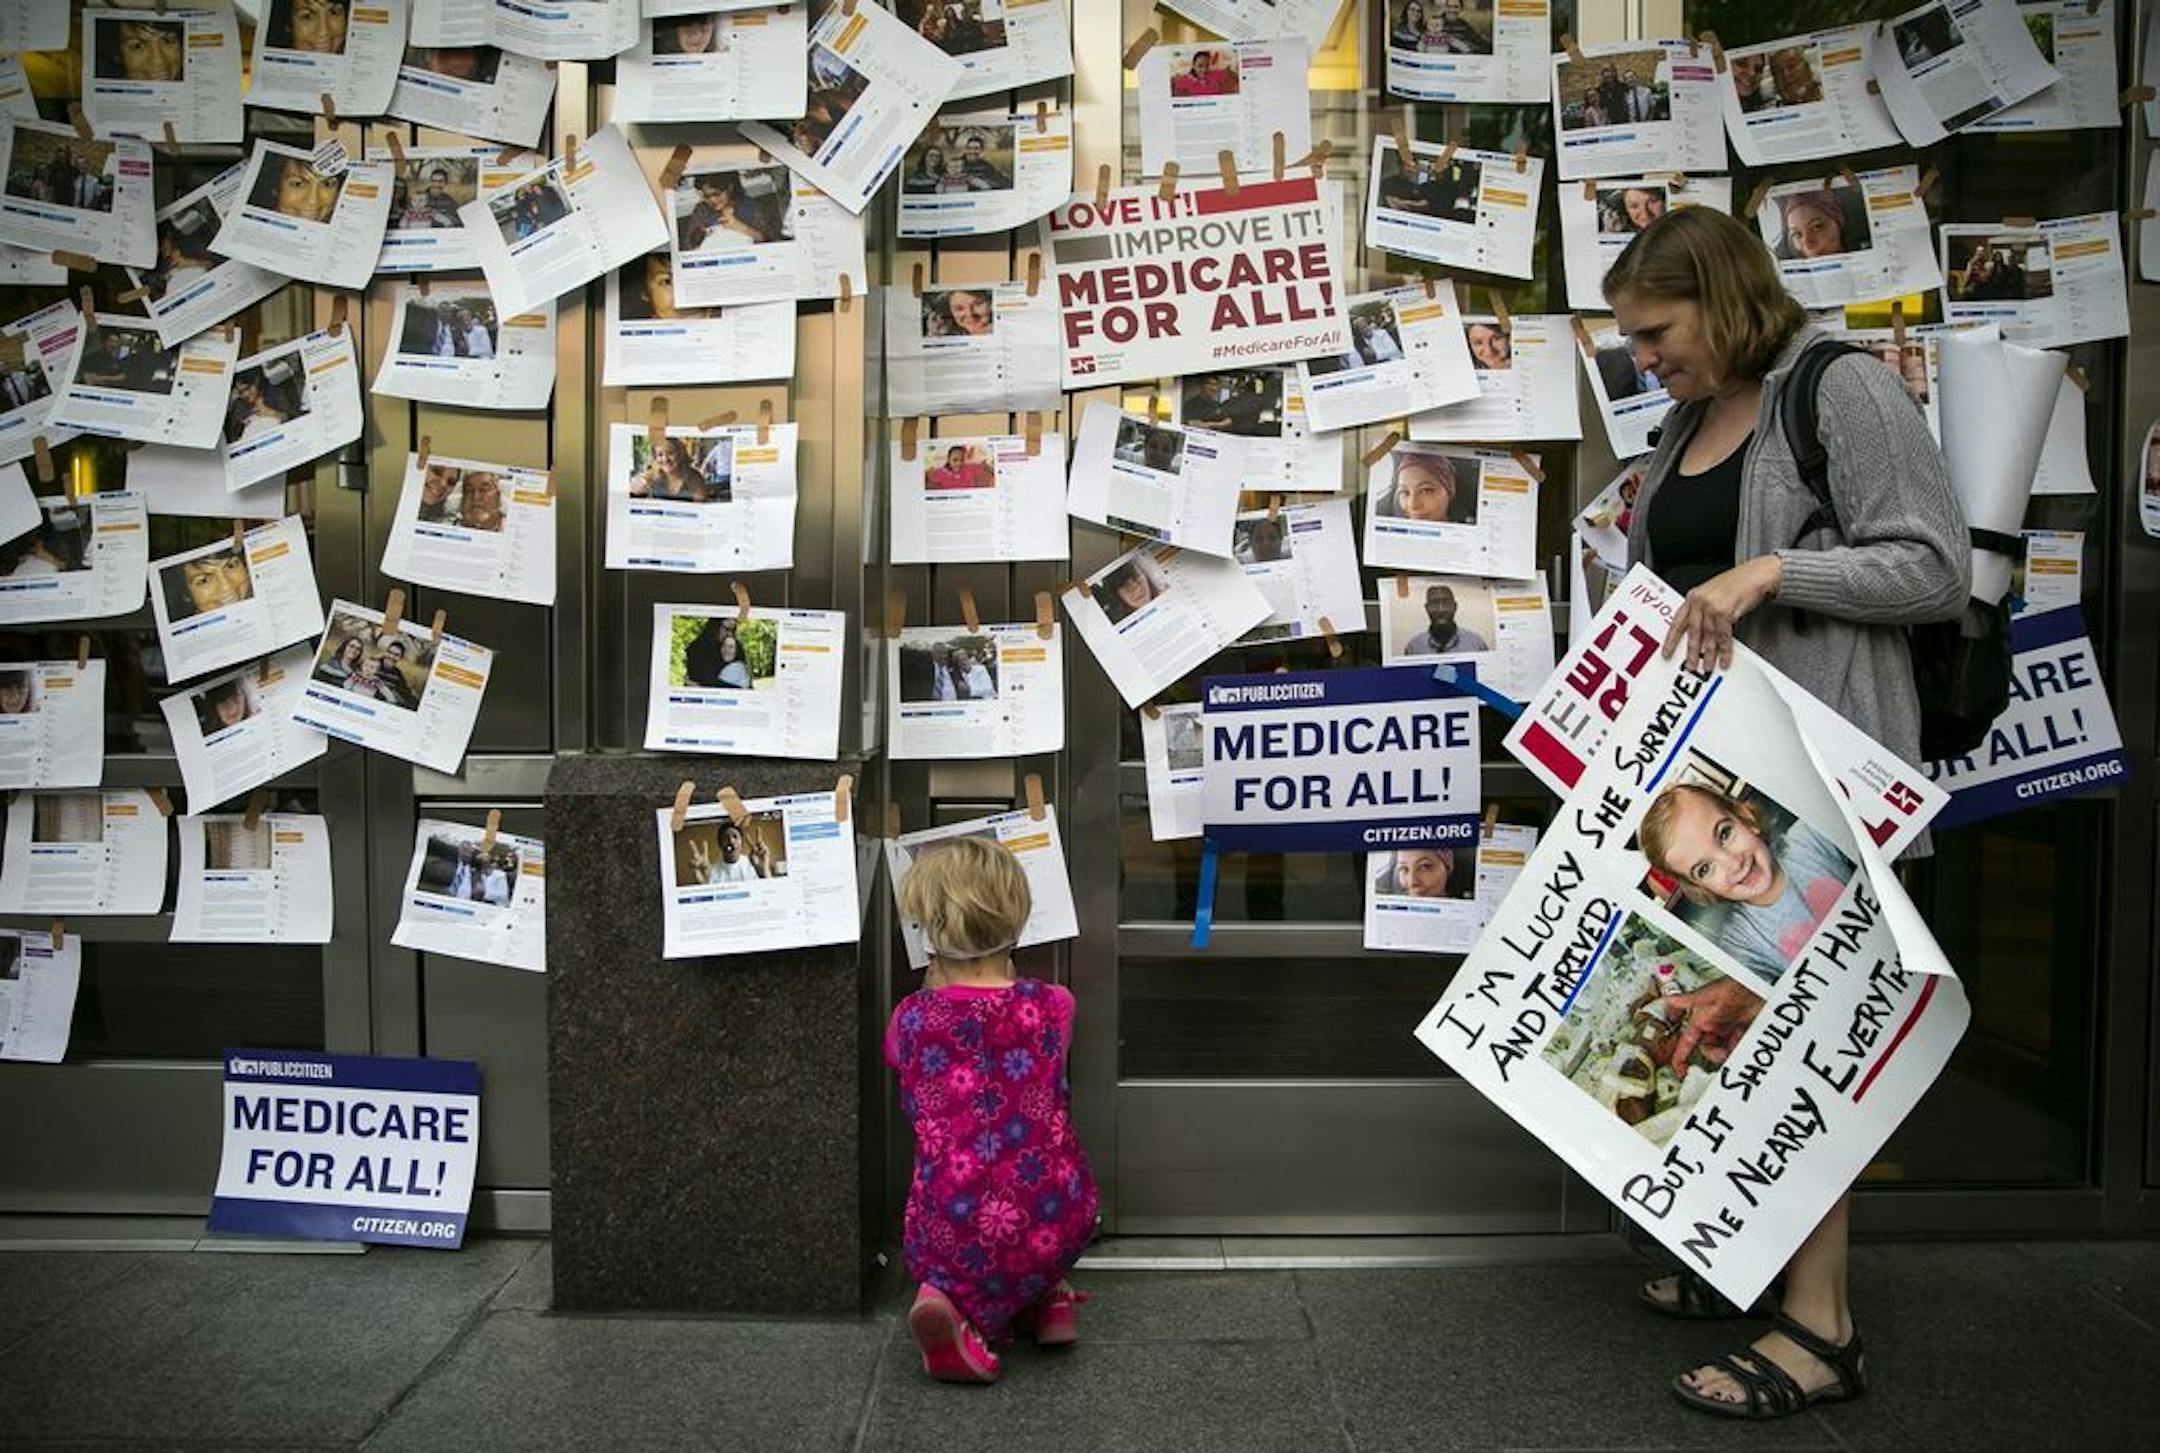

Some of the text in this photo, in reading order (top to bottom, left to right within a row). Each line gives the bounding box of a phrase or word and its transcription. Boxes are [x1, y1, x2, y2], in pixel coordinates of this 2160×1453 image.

[1050, 197, 1143, 232] LOVE
[1152, 192, 1194, 220] IT!
[1114, 208, 1324, 258] IMPROVE IT!
[1057, 243, 1331, 308] MEDICARE
[1063, 281, 1337, 349] FOR ALL!
[1212, 330, 1341, 359] #MedicareForAll
[1241, 682, 1325, 703] PUBLICCITIZEN
[1541, 689, 1591, 740] IT!
[1214, 711, 1470, 761] MEDICARE
[1988, 708, 2089, 766] ALL!
[1235, 767, 1450, 811] FOR ALL!
[2016, 759, 2123, 798] CITIZEN.ORG
[1363, 823, 1473, 843] CITIZEN.ORG
[1436, 970, 1515, 1050] I'M
[1500, 850, 1585, 962] LUCKY
[1577, 786, 1632, 849] SHE
[258, 1060, 333, 1079] PUBLICCITIZEN
[1489, 1009, 1547, 1082] AND
[1621, 1145, 1705, 1220] BUT,
[1684, 1105, 1734, 1154] IT
[1814, 882, 1881, 971] HAVE
[233, 1096, 469, 1143] MEDICARE
[246, 1149, 447, 1197] FOR ALL!
[1681, 1206, 1745, 1269] ME
[1725, 1086, 1827, 1208] NEARLY
[352, 1216, 456, 1239] CITIZEN.ORG
